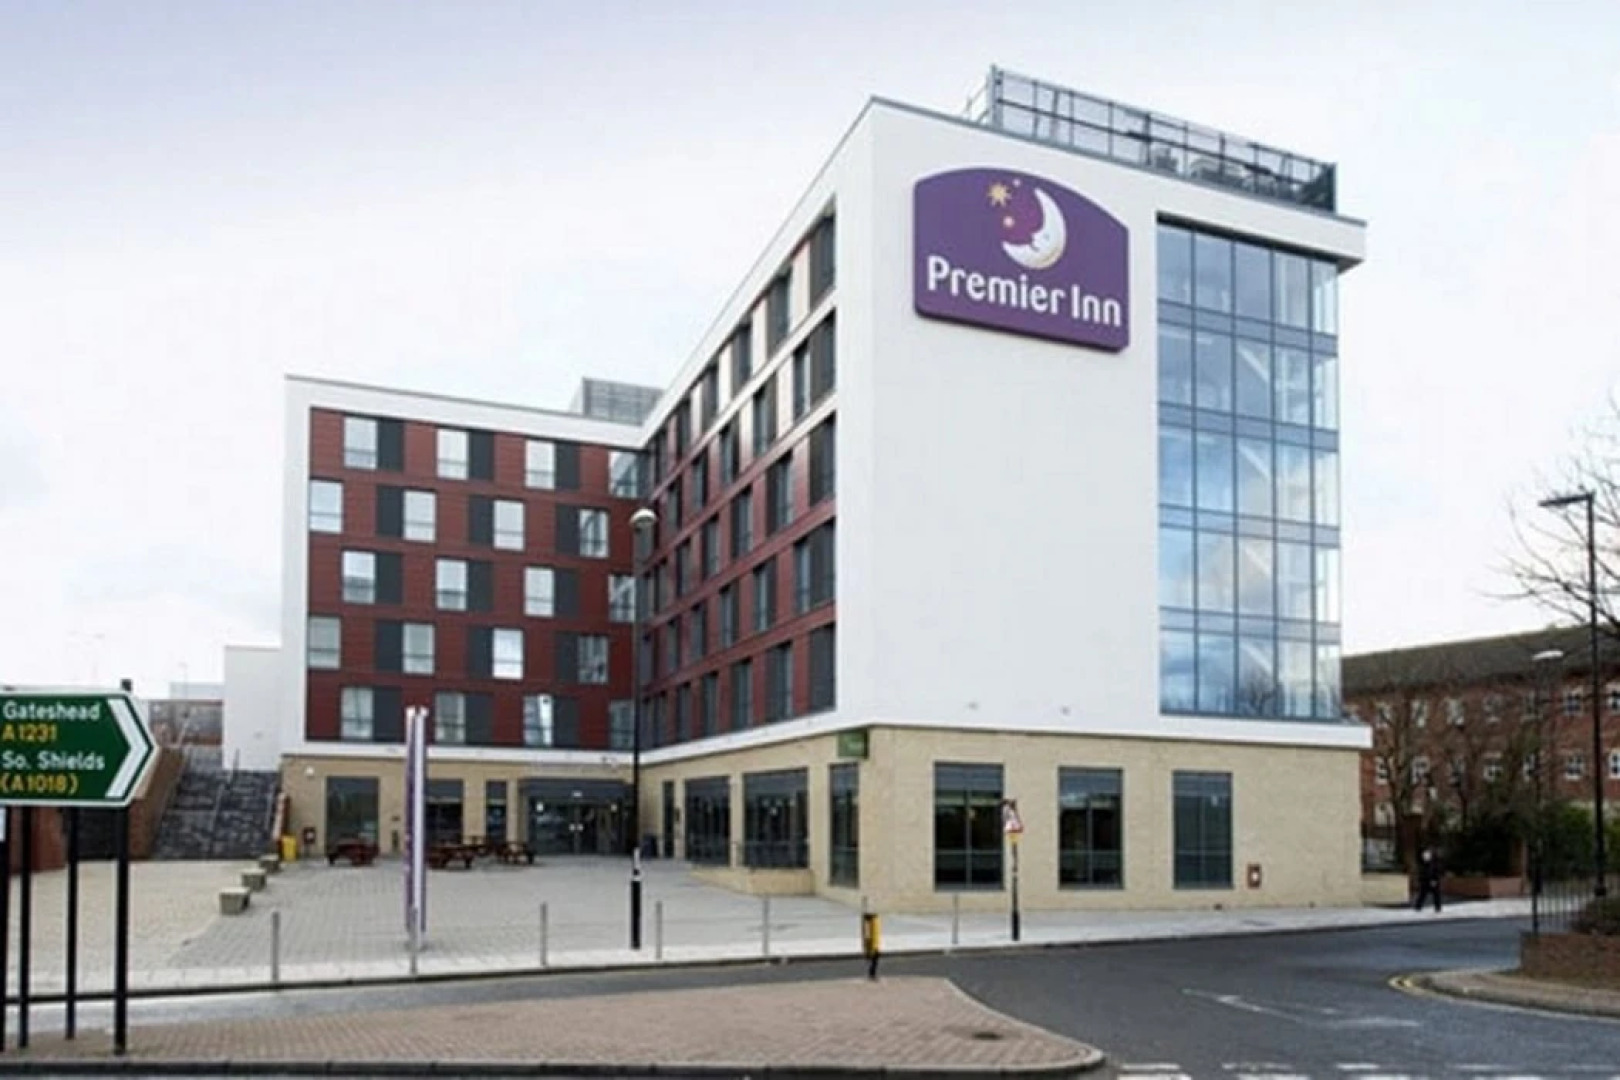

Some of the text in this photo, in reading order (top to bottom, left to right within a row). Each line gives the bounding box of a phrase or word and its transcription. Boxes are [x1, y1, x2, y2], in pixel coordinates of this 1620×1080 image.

[927, 255, 1121, 327] Premier Inn
[3, 701, 101, 720] Gateshead
[2, 723, 57, 742] A1231
[2, 750, 105, 770] So. Shields
